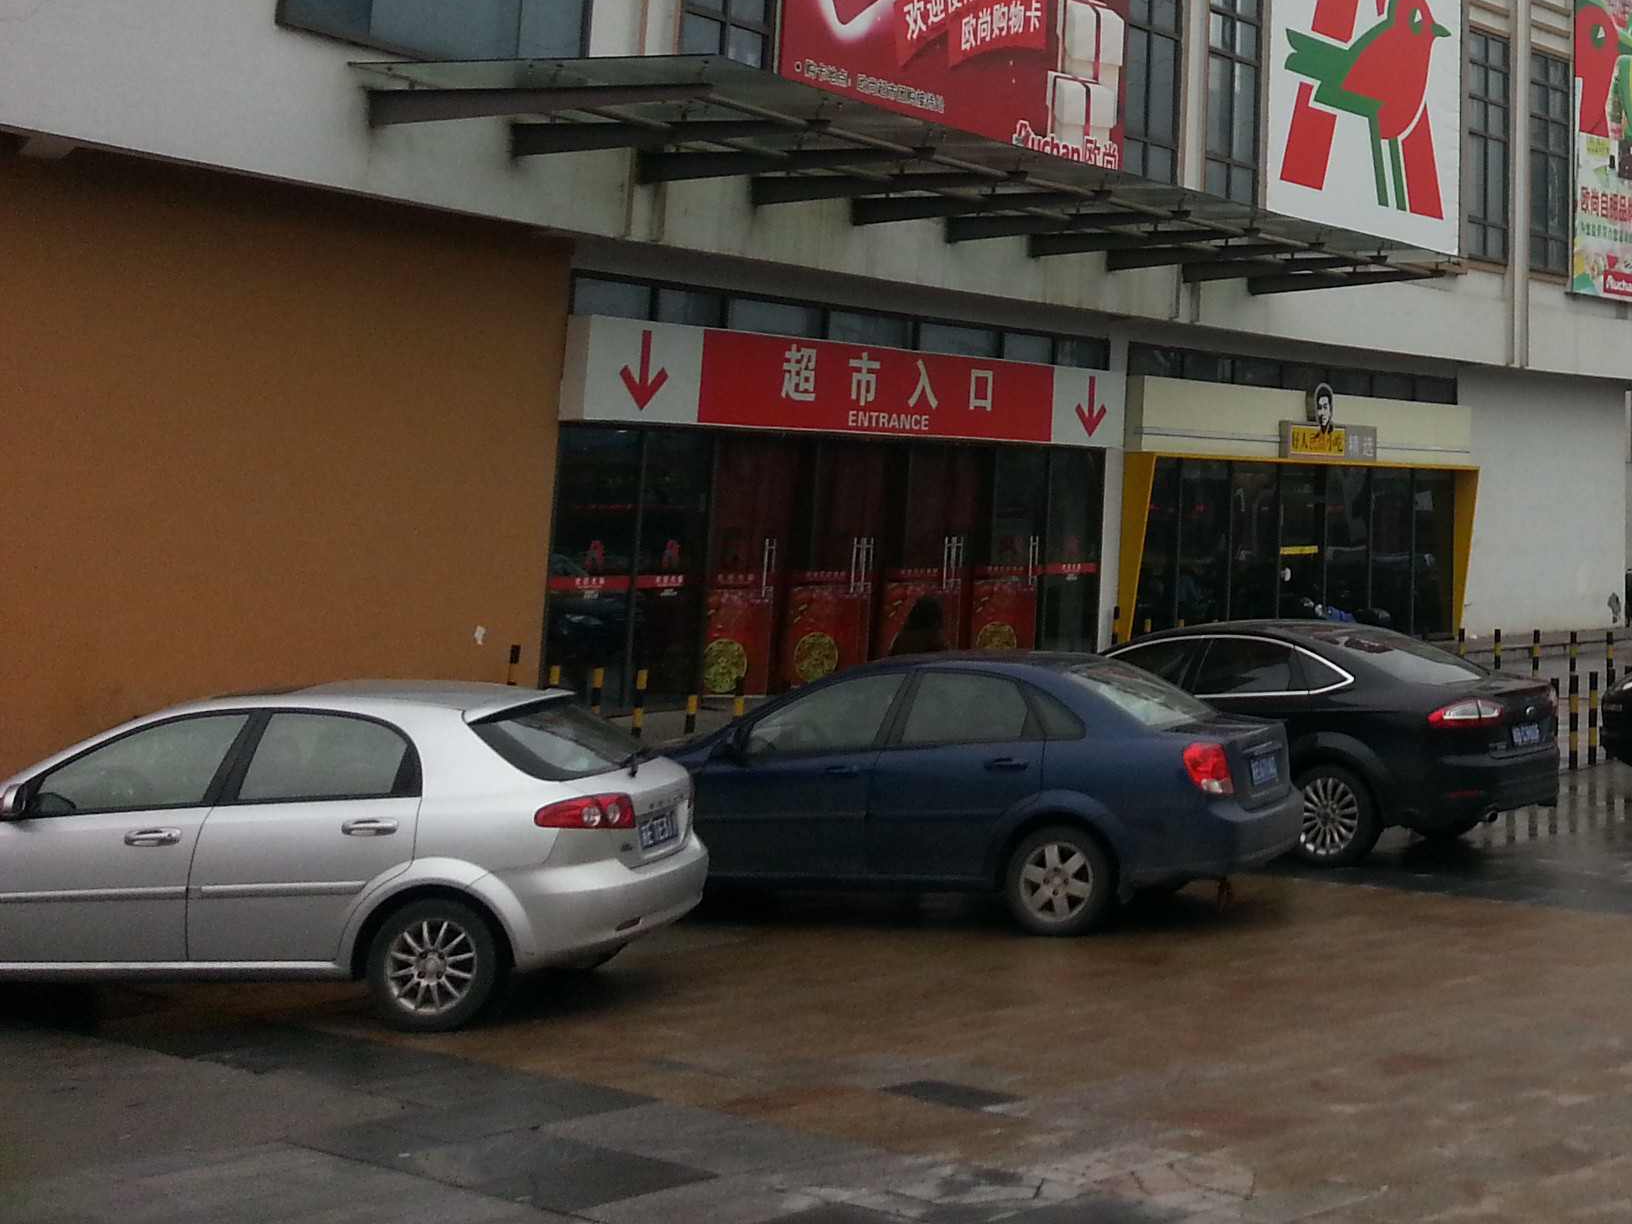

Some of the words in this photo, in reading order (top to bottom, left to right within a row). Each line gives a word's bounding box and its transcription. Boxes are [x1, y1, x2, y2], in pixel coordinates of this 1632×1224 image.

[961, 0, 1043, 51] 欧尚购物卡
[781, 343, 996, 413] 超市入口
[847, 409, 931, 432] ENTRANCE
